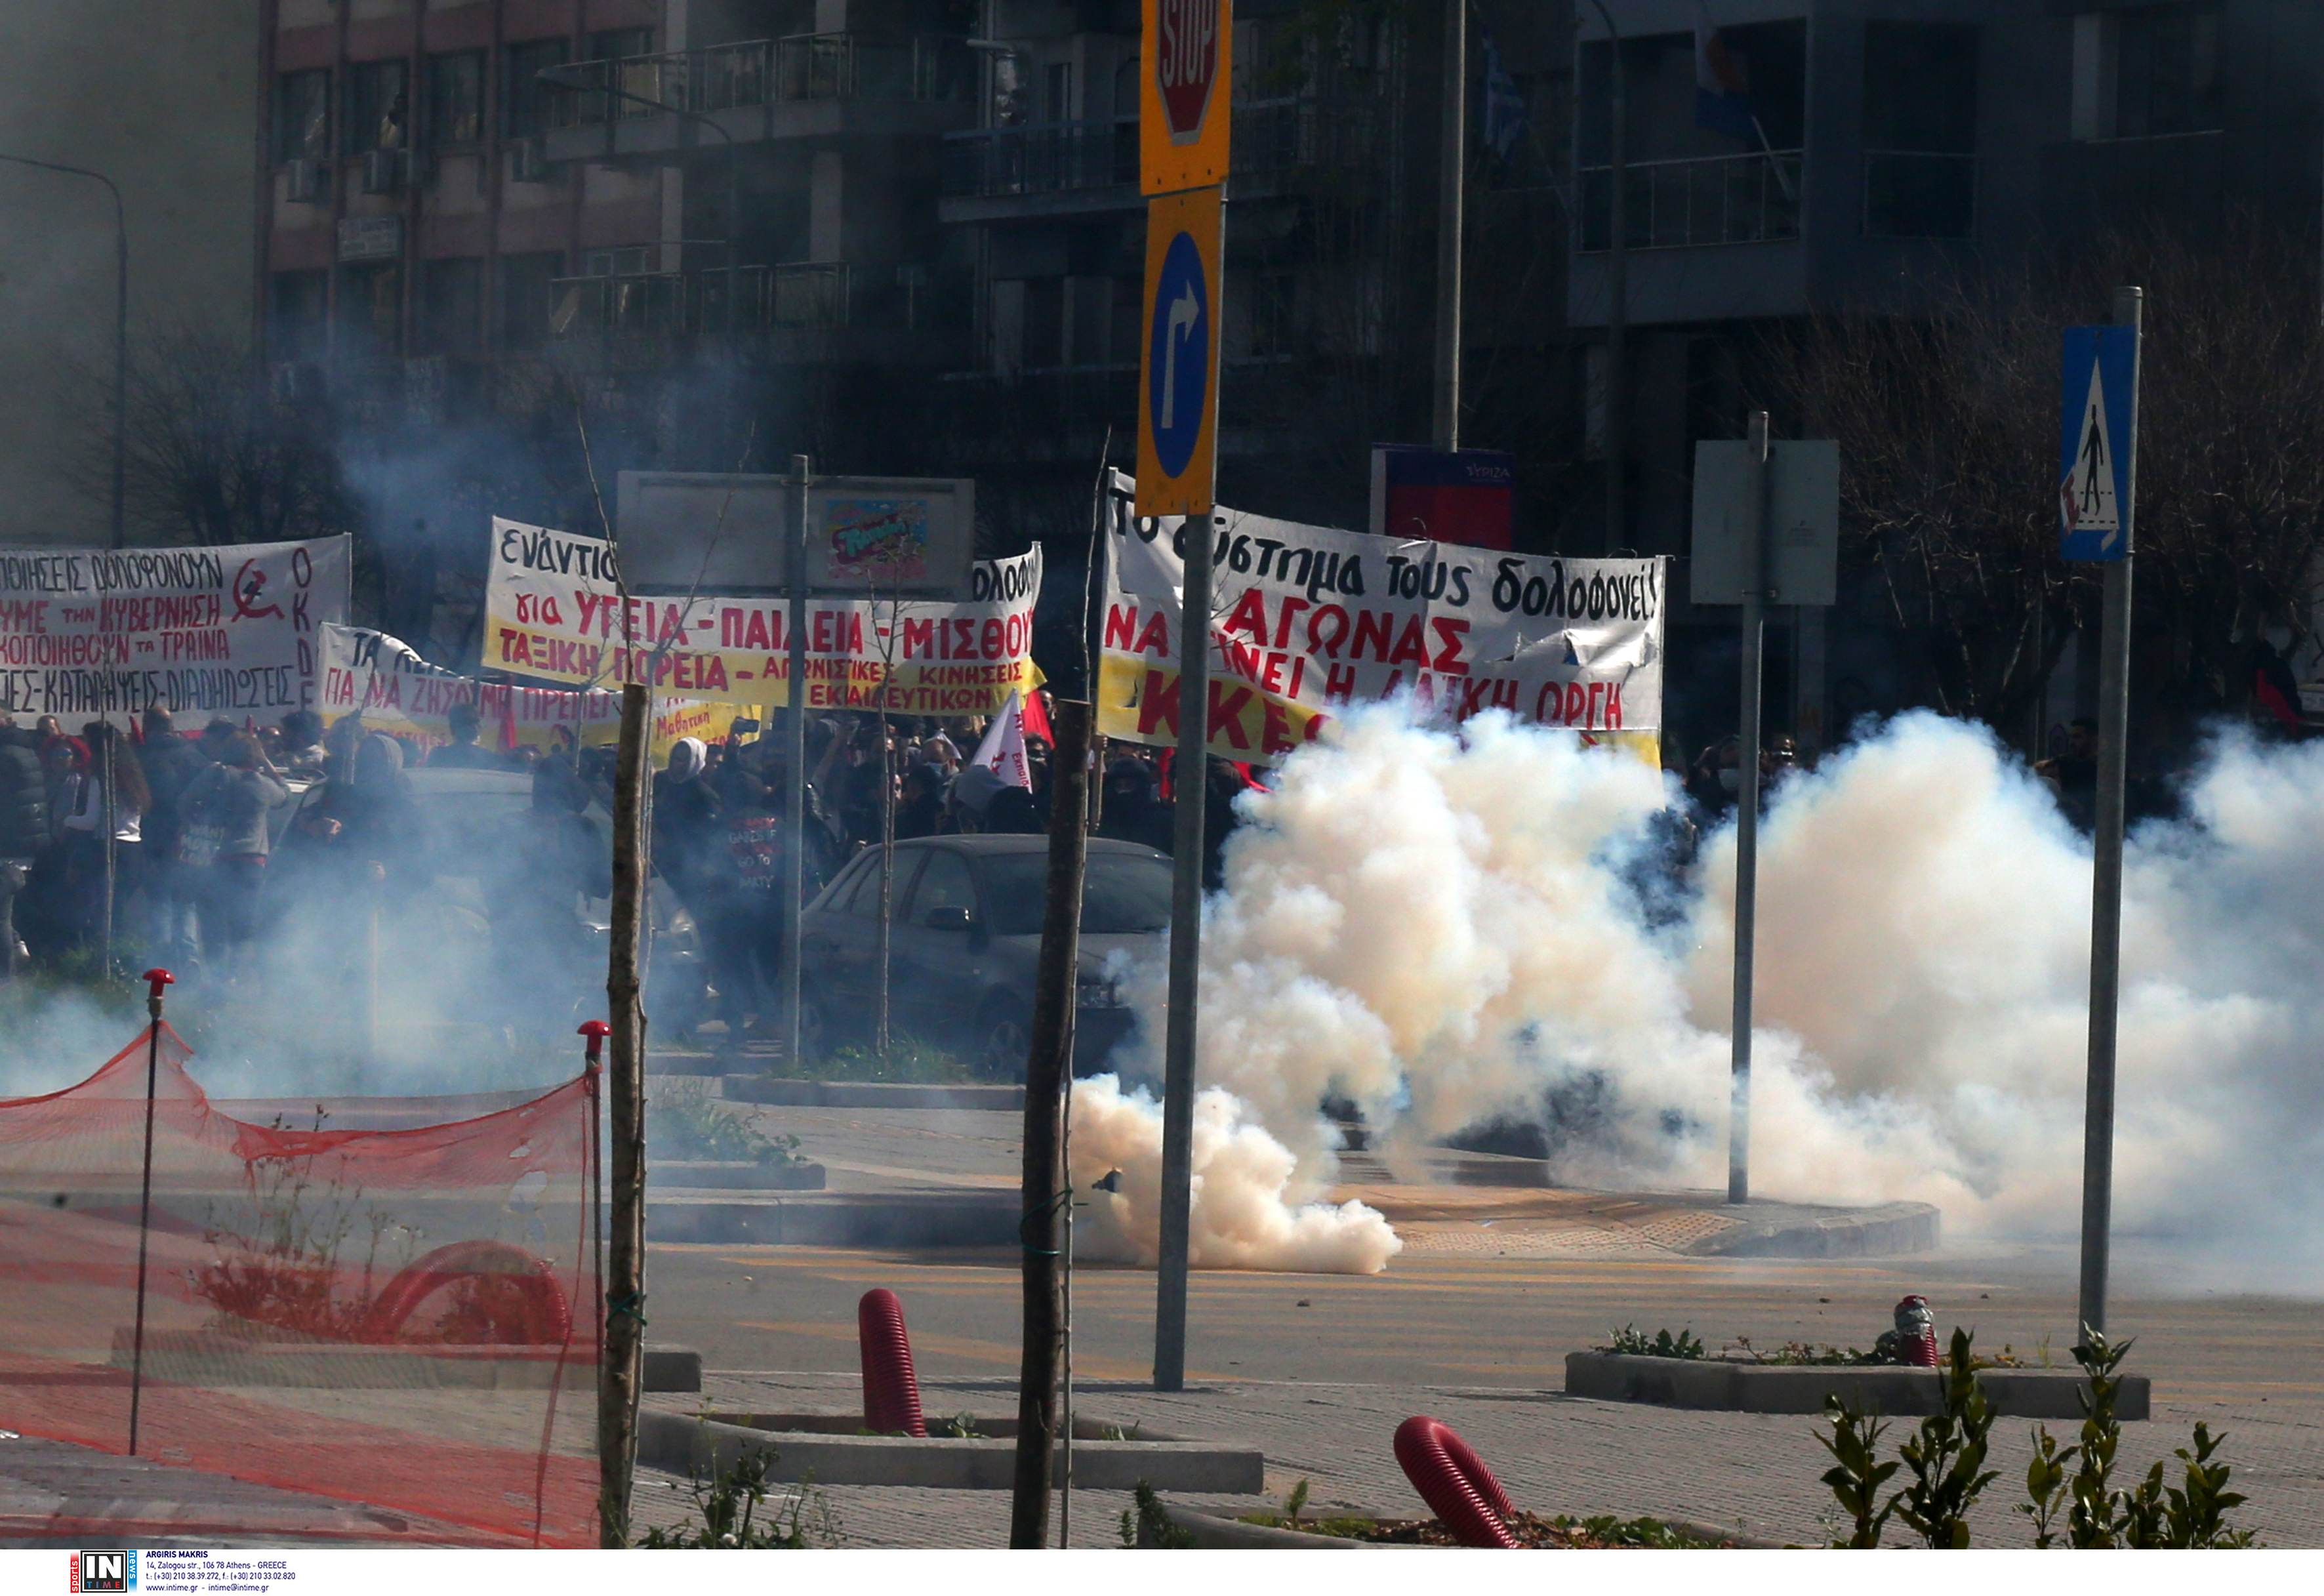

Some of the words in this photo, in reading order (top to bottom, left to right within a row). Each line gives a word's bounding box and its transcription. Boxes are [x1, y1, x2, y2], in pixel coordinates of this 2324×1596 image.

[1163, 0, 1215, 87] STOP
[99, 594, 221, 633] ΚΥΒΕΡΝΗΣΗ
[903, 606, 1034, 661] ΜΙΣΘΟΥ
[1223, 587, 1471, 675] ΑΓΩΝΑΣ
[159, 628, 230, 662] ΤΡΑΙΝΑ
[500, 628, 599, 678] ΤΑΞΙΚΗ
[920, 661, 1023, 685] ΚΙΝΗΣΕΙΣ
[1105, 603, 1169, 658] ΝΑ
[1210, 630, 1305, 700] ΙΝΕΙ
[1536, 681, 1622, 731] ΟΡΓΗ
